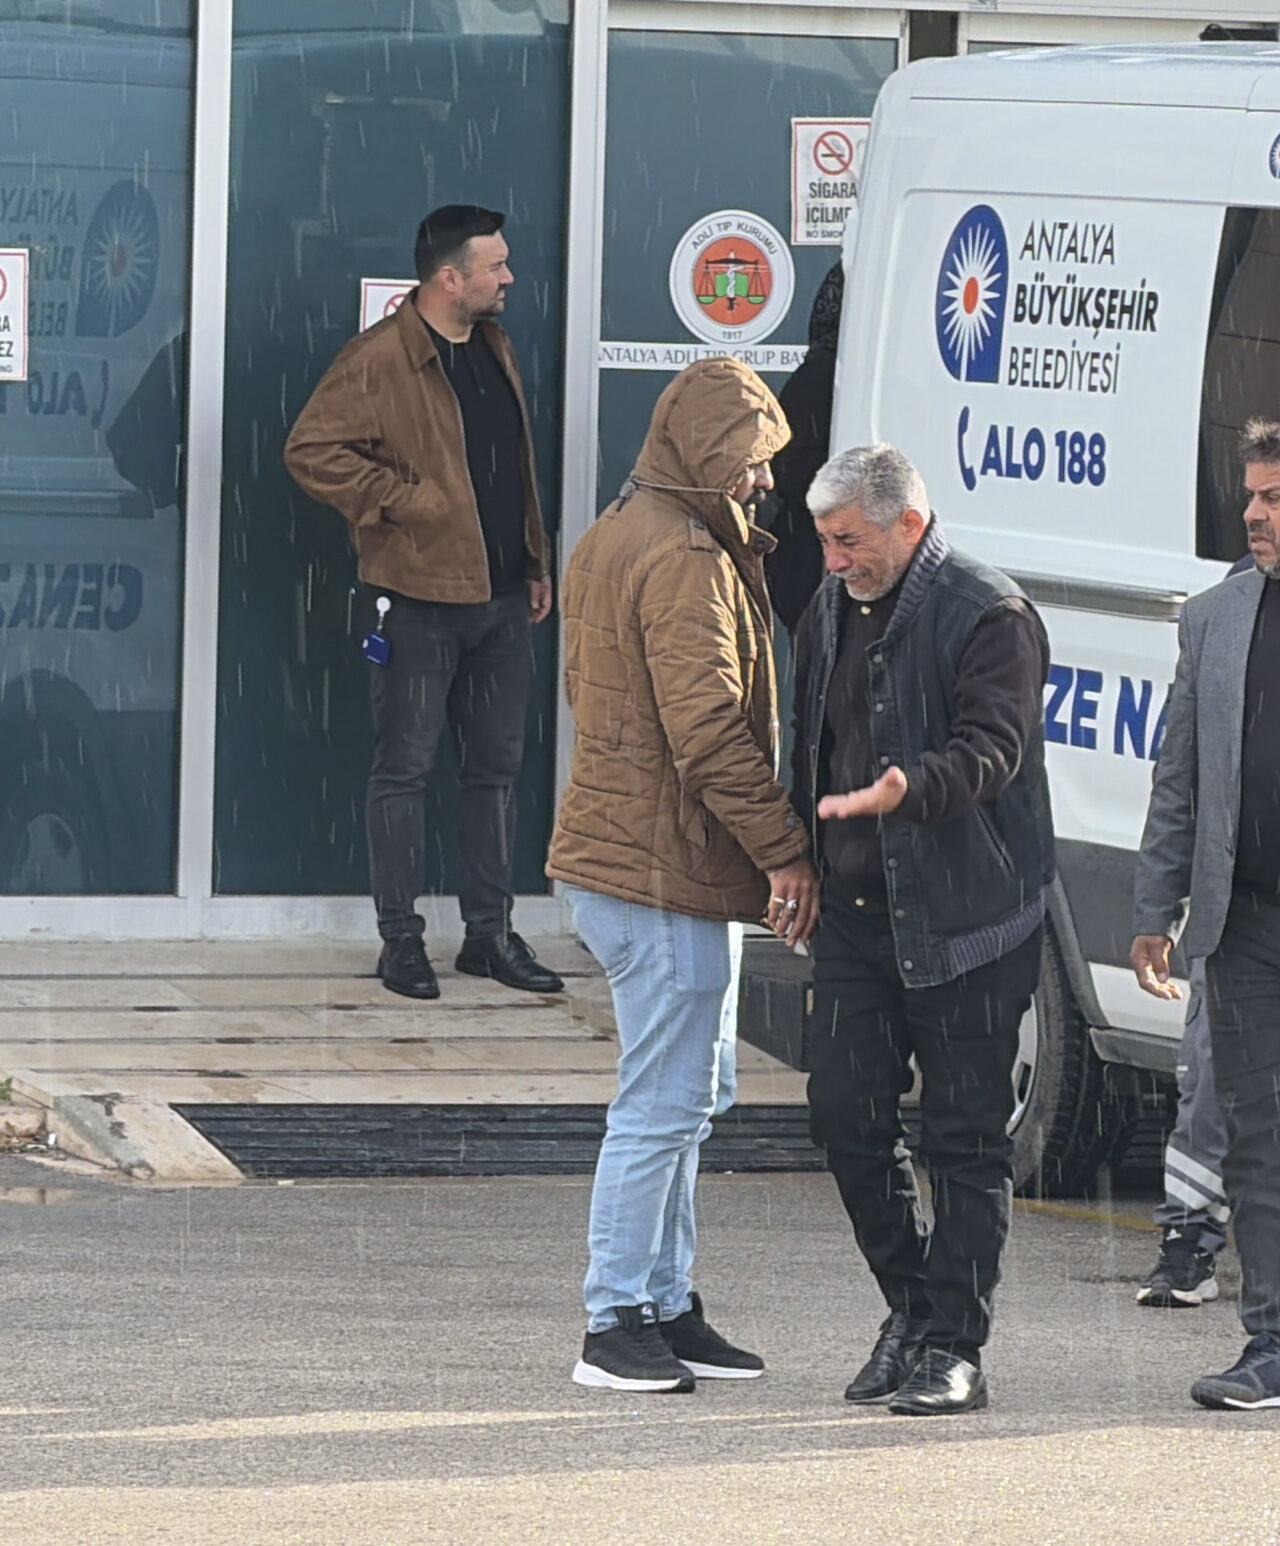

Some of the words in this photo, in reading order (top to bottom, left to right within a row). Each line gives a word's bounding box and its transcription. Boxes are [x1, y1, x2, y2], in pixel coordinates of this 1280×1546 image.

[809, 177, 858, 199] SİGARA
[691, 225, 714, 251] ADLİ
[716, 221, 733, 232] TIP
[736, 222, 778, 255] KURUMU
[1019, 219, 1116, 266] ANTALYA
[1013, 271, 1159, 340] BÜYÜKŞEHİR
[722, 331, 743, 340] 1917
[598, 347, 657, 363] NTALYA
[732, 350, 775, 365] GRUP
[1007, 338, 1121, 395] BELEDİYESİ
[980, 424, 1046, 481] ALO
[1055, 430, 1106, 487] 188
